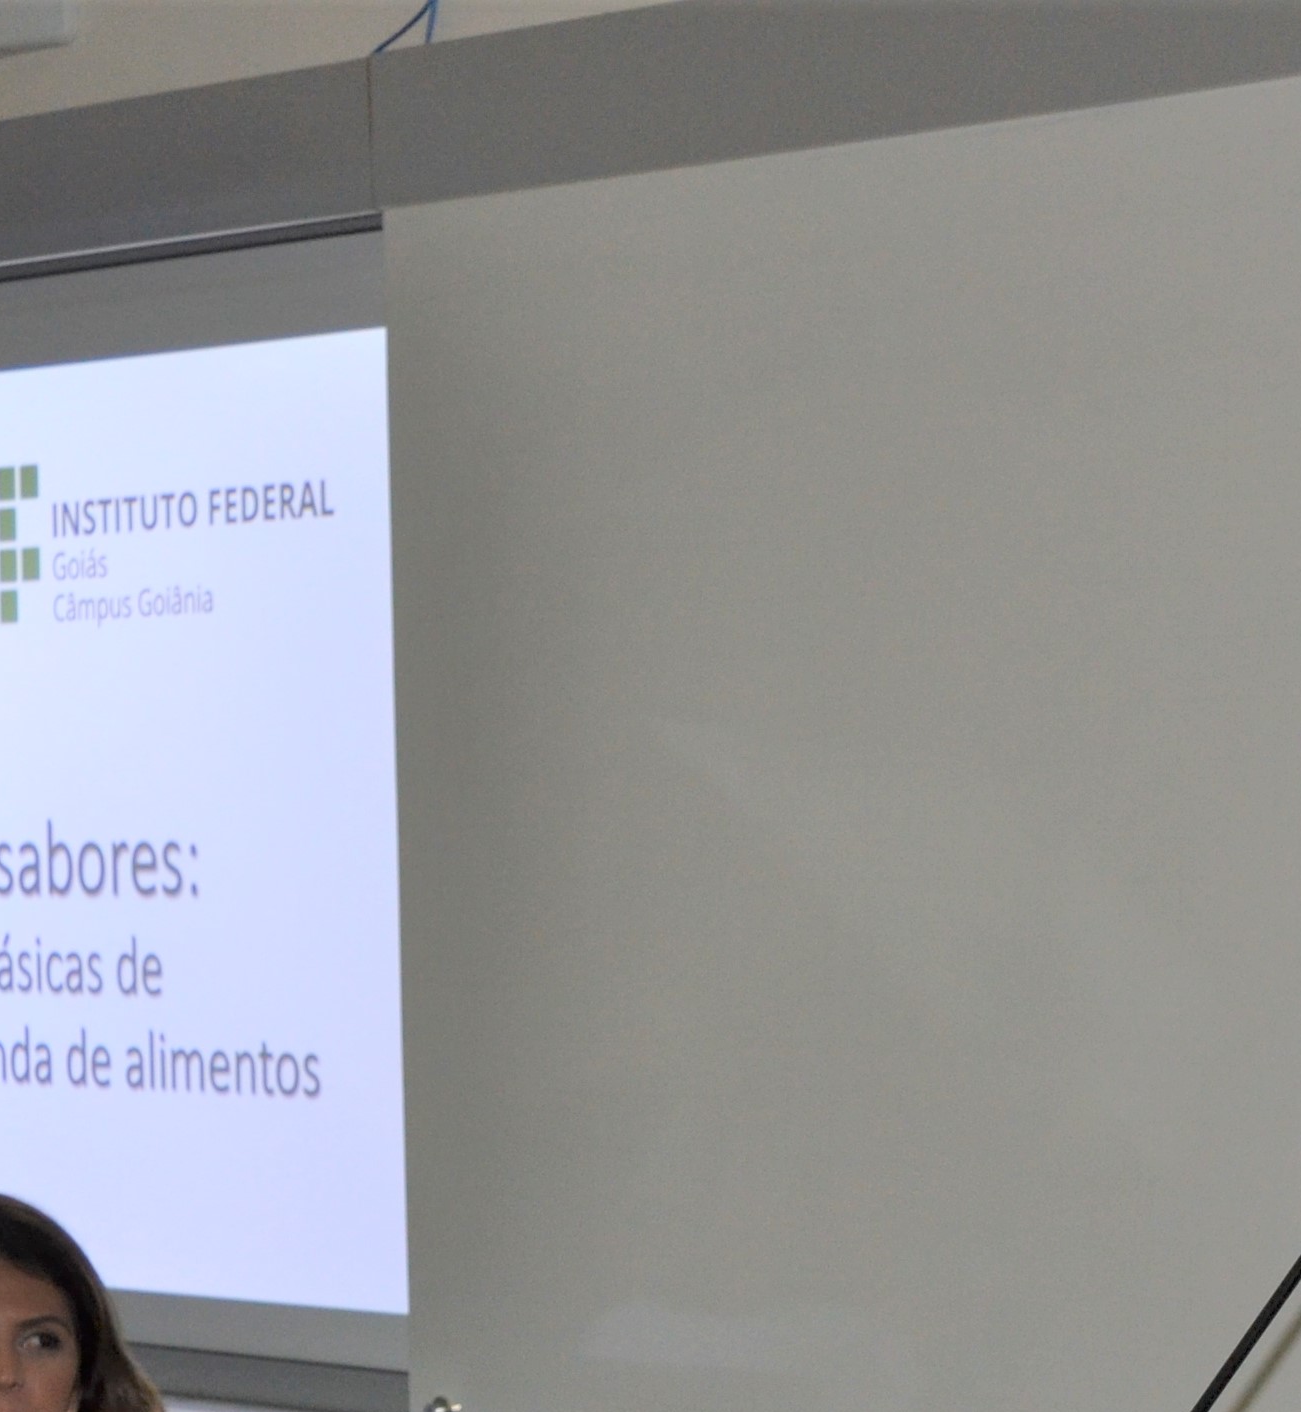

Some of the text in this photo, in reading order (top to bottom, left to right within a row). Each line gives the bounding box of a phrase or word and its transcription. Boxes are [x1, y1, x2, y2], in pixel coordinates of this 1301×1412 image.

[51, 479, 336, 539] INSTITUTO FEDERAL
[52, 547, 109, 582] Goiás
[52, 584, 215, 629] Câmpus Goiânia
[116, 935, 164, 998] de
[65, 1027, 112, 1089] de
[124, 1028, 323, 1100] alimentos
